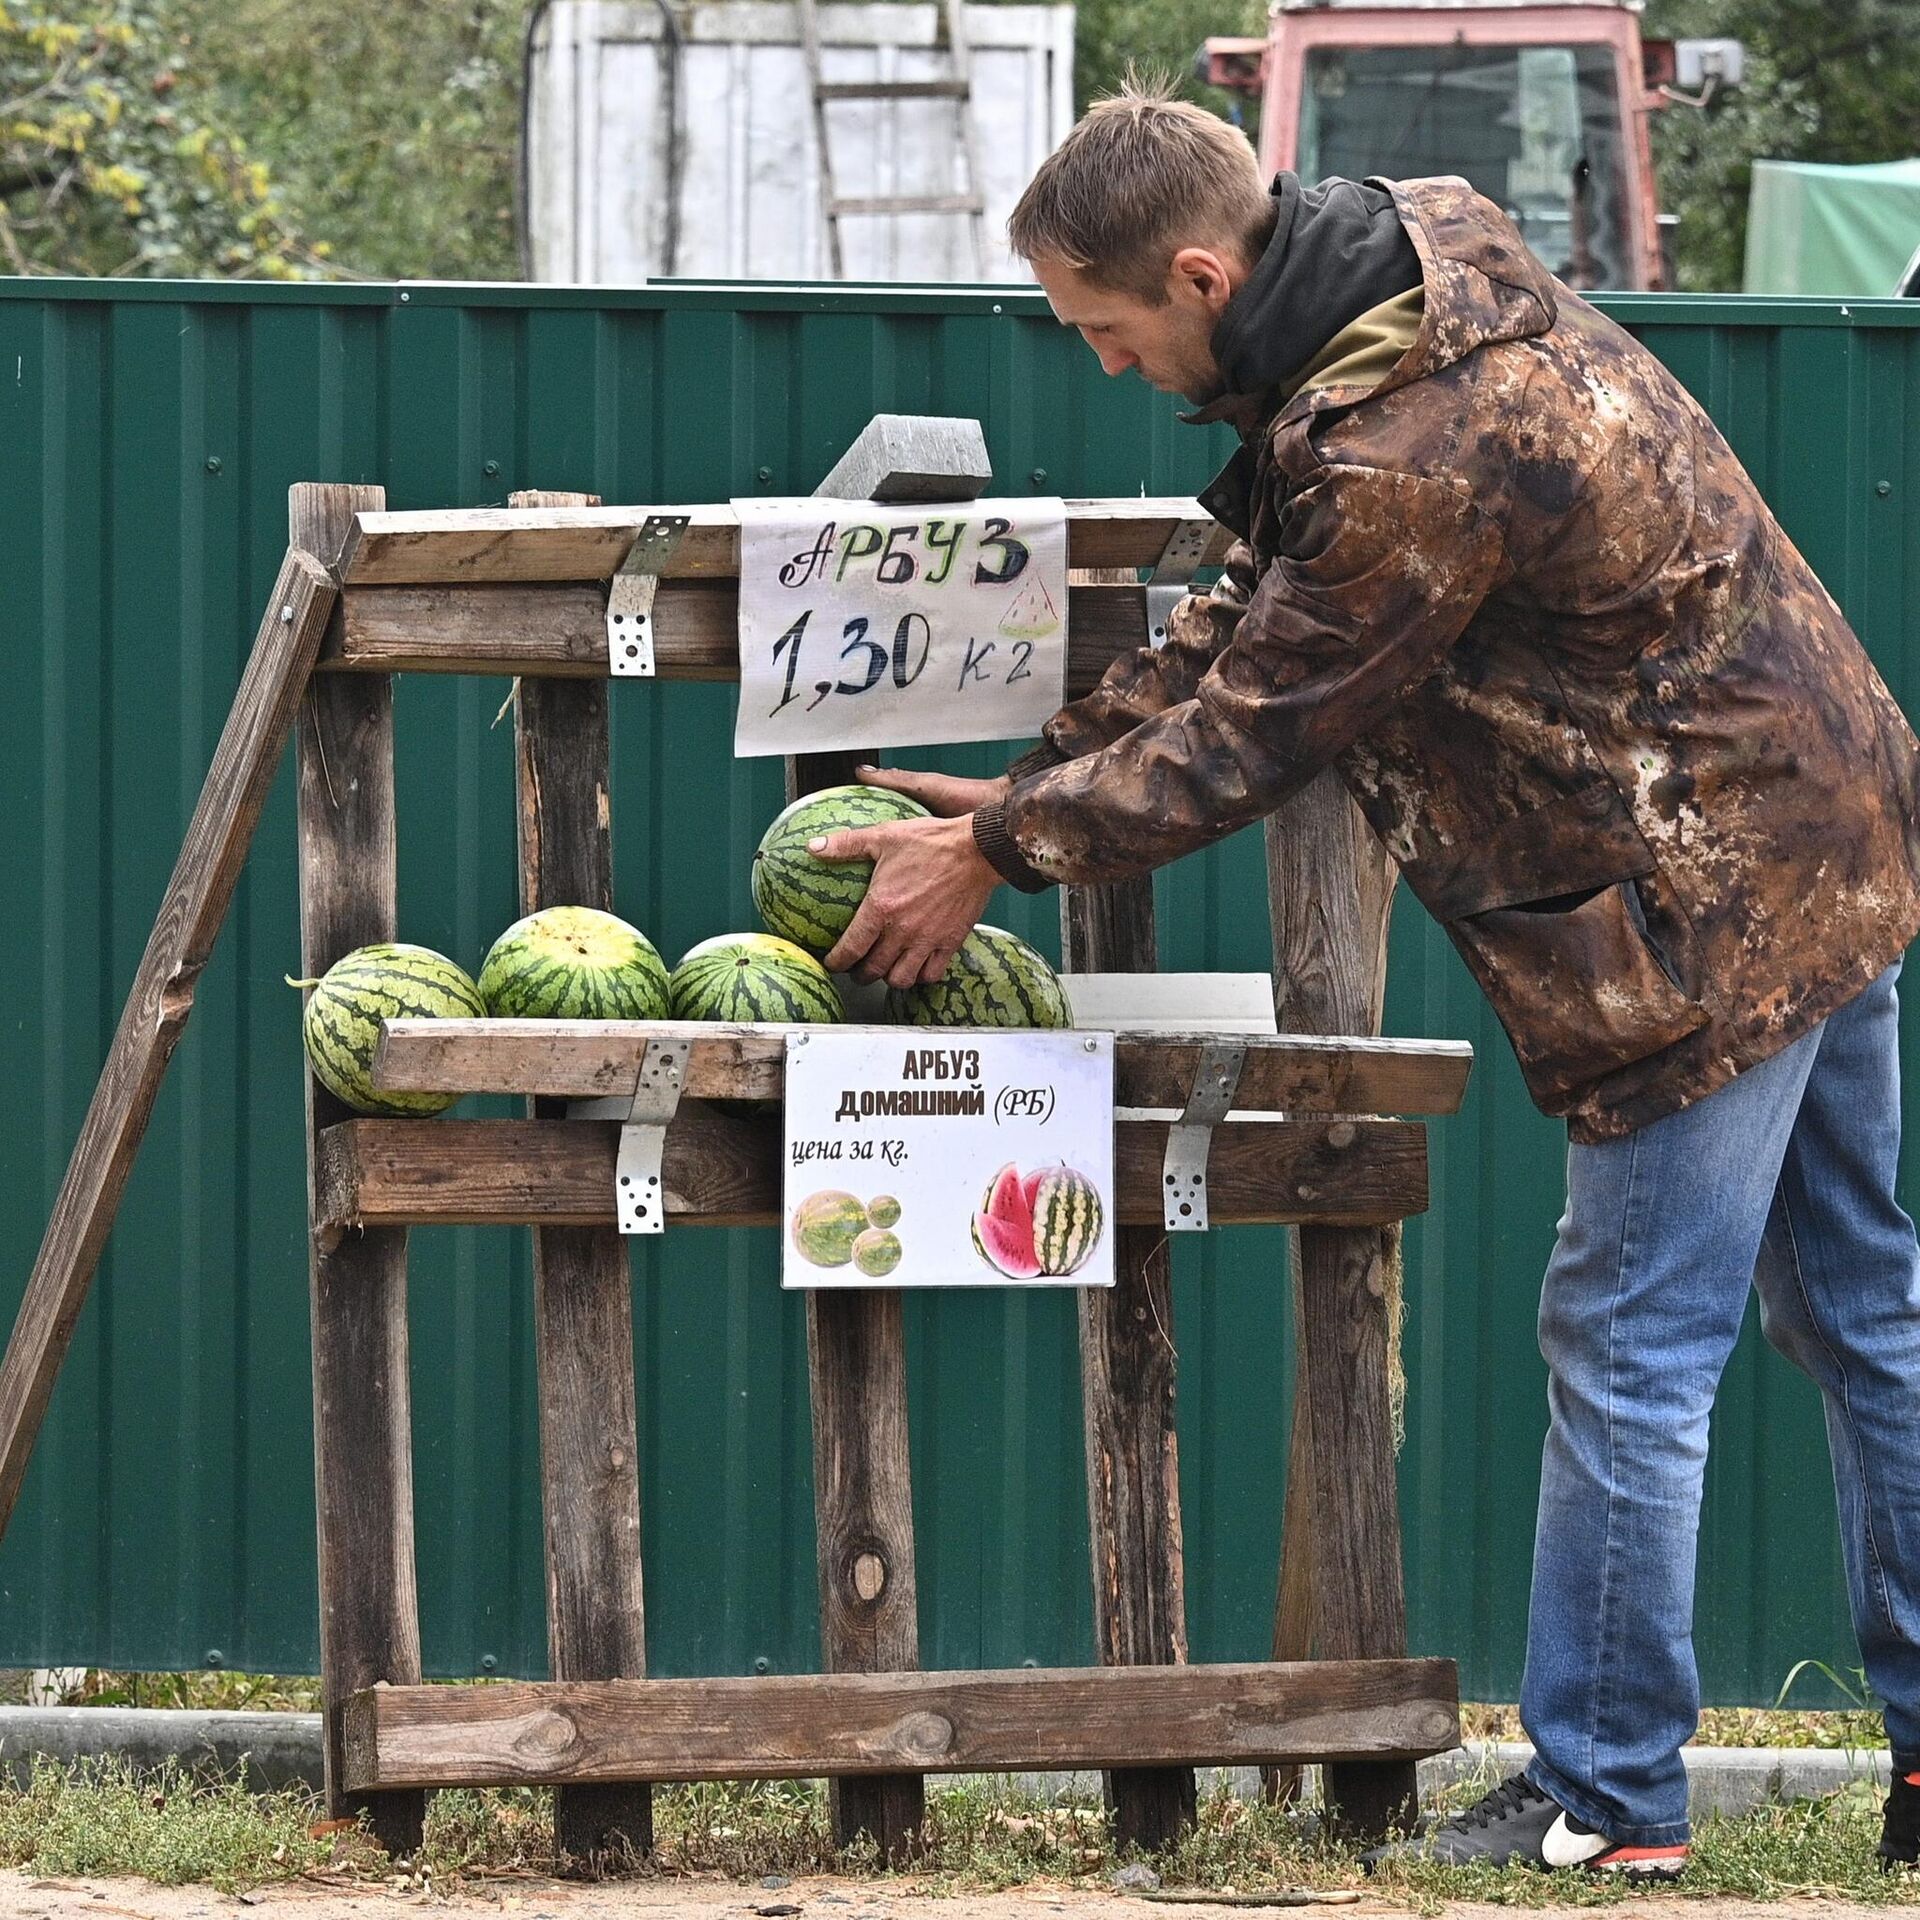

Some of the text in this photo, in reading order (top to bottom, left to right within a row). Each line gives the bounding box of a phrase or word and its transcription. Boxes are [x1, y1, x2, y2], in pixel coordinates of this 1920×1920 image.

[778, 517, 1031, 588] АРБУЗ
[769, 609, 931, 718] 1,30
[902, 1049, 980, 1080] АРБУЗ
[994, 1084, 1055, 1126] (РБ)
[791, 1139, 909, 1168] цена за кг.
